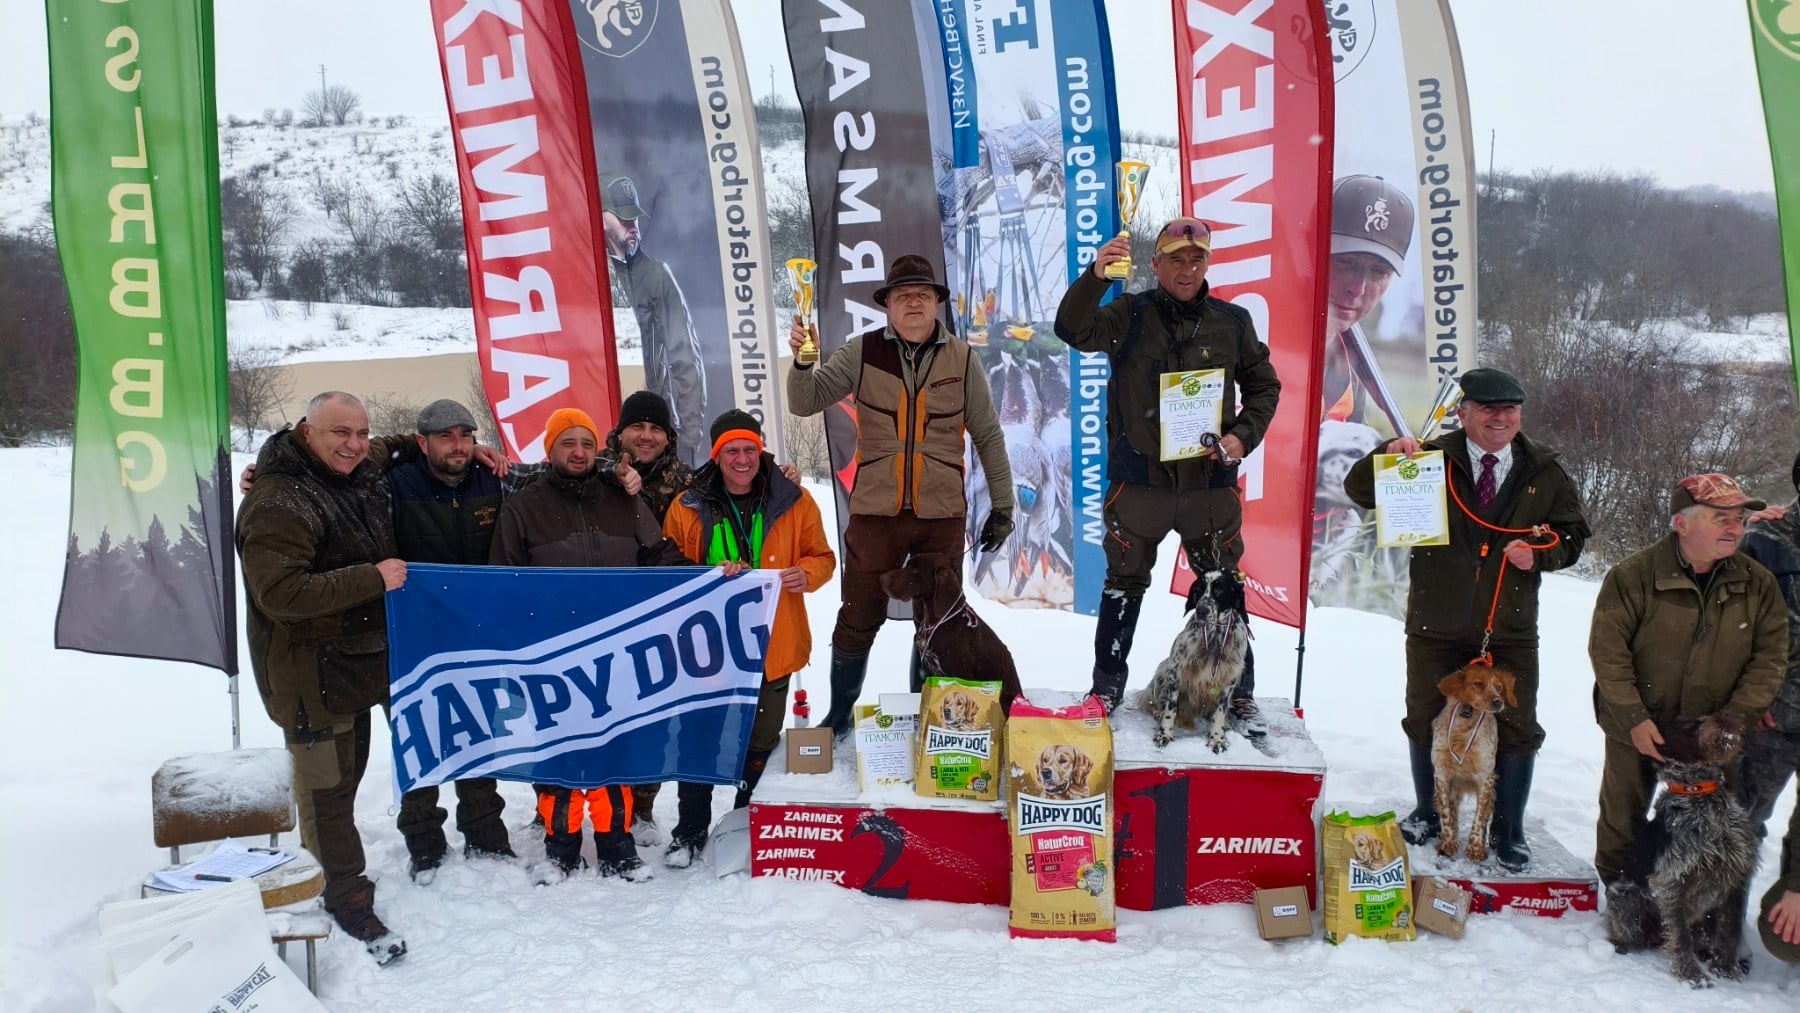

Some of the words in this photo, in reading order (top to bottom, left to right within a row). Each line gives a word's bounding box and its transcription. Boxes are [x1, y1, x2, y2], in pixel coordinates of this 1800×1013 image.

[1169, 399, 1213, 412] ГРАМОТА
[1385, 485, 1434, 495] ГРАМОТА
[391, 653, 614, 791] HAPPY
[625, 585, 770, 700] DOG
[865, 732, 906, 743] ГРАМОТА
[928, 732, 963, 749] HAPPY
[965, 736, 987, 753] DOG
[784, 811, 844, 824] ZARIMEX
[1021, 803, 1071, 826] HAPPY
[1072, 804, 1102, 826] DOG
[759, 825, 845, 842] ZARIMEX
[1037, 835, 1085, 850] NaturCroq
[1197, 837, 1303, 857] ZARIMEX
[756, 848, 816, 861] ZARIMEX
[851, 814, 911, 900] 2
[1040, 853, 1065, 863] ACTIVE
[762, 867, 846, 884] ZARIMEX
[1383, 865, 1405, 884] DOG
[1510, 896, 1573, 910] ZARIMEX
[227, 981, 254, 1007] HAPPY
[252, 966, 271, 985] CAT
